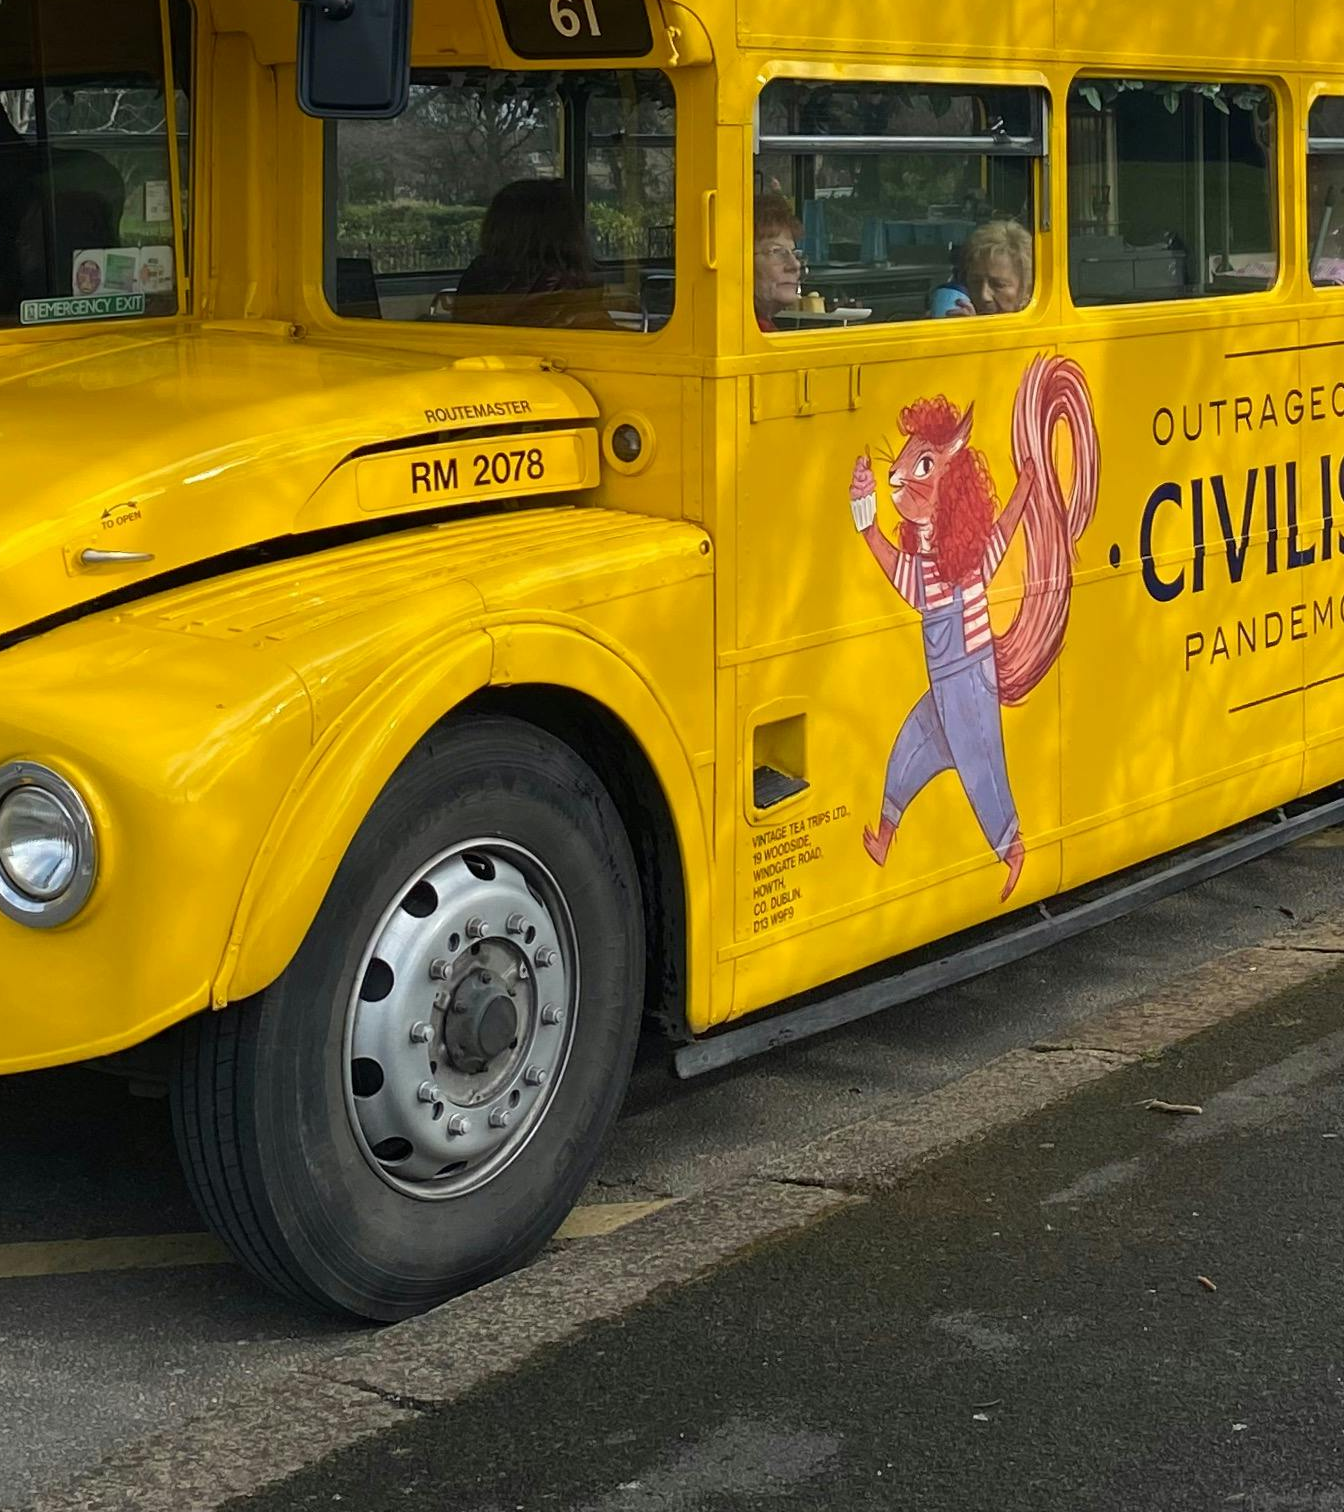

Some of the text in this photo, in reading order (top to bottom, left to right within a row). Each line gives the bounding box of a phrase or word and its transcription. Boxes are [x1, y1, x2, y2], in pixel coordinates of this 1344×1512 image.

[39, 294, 143, 318] EMERGENCY EXIT
[424, 399, 532, 424] ROUTEMASTER
[411, 448, 545, 494] RM 2078
[752, 826, 786, 848] VINTAGE
[789, 820, 805, 835] TEA
[808, 811, 830, 828] TRIPS
[753, 852, 762, 865] 19
[753, 856, 796, 882] WINDGATE
[754, 917, 768, 933] D13
